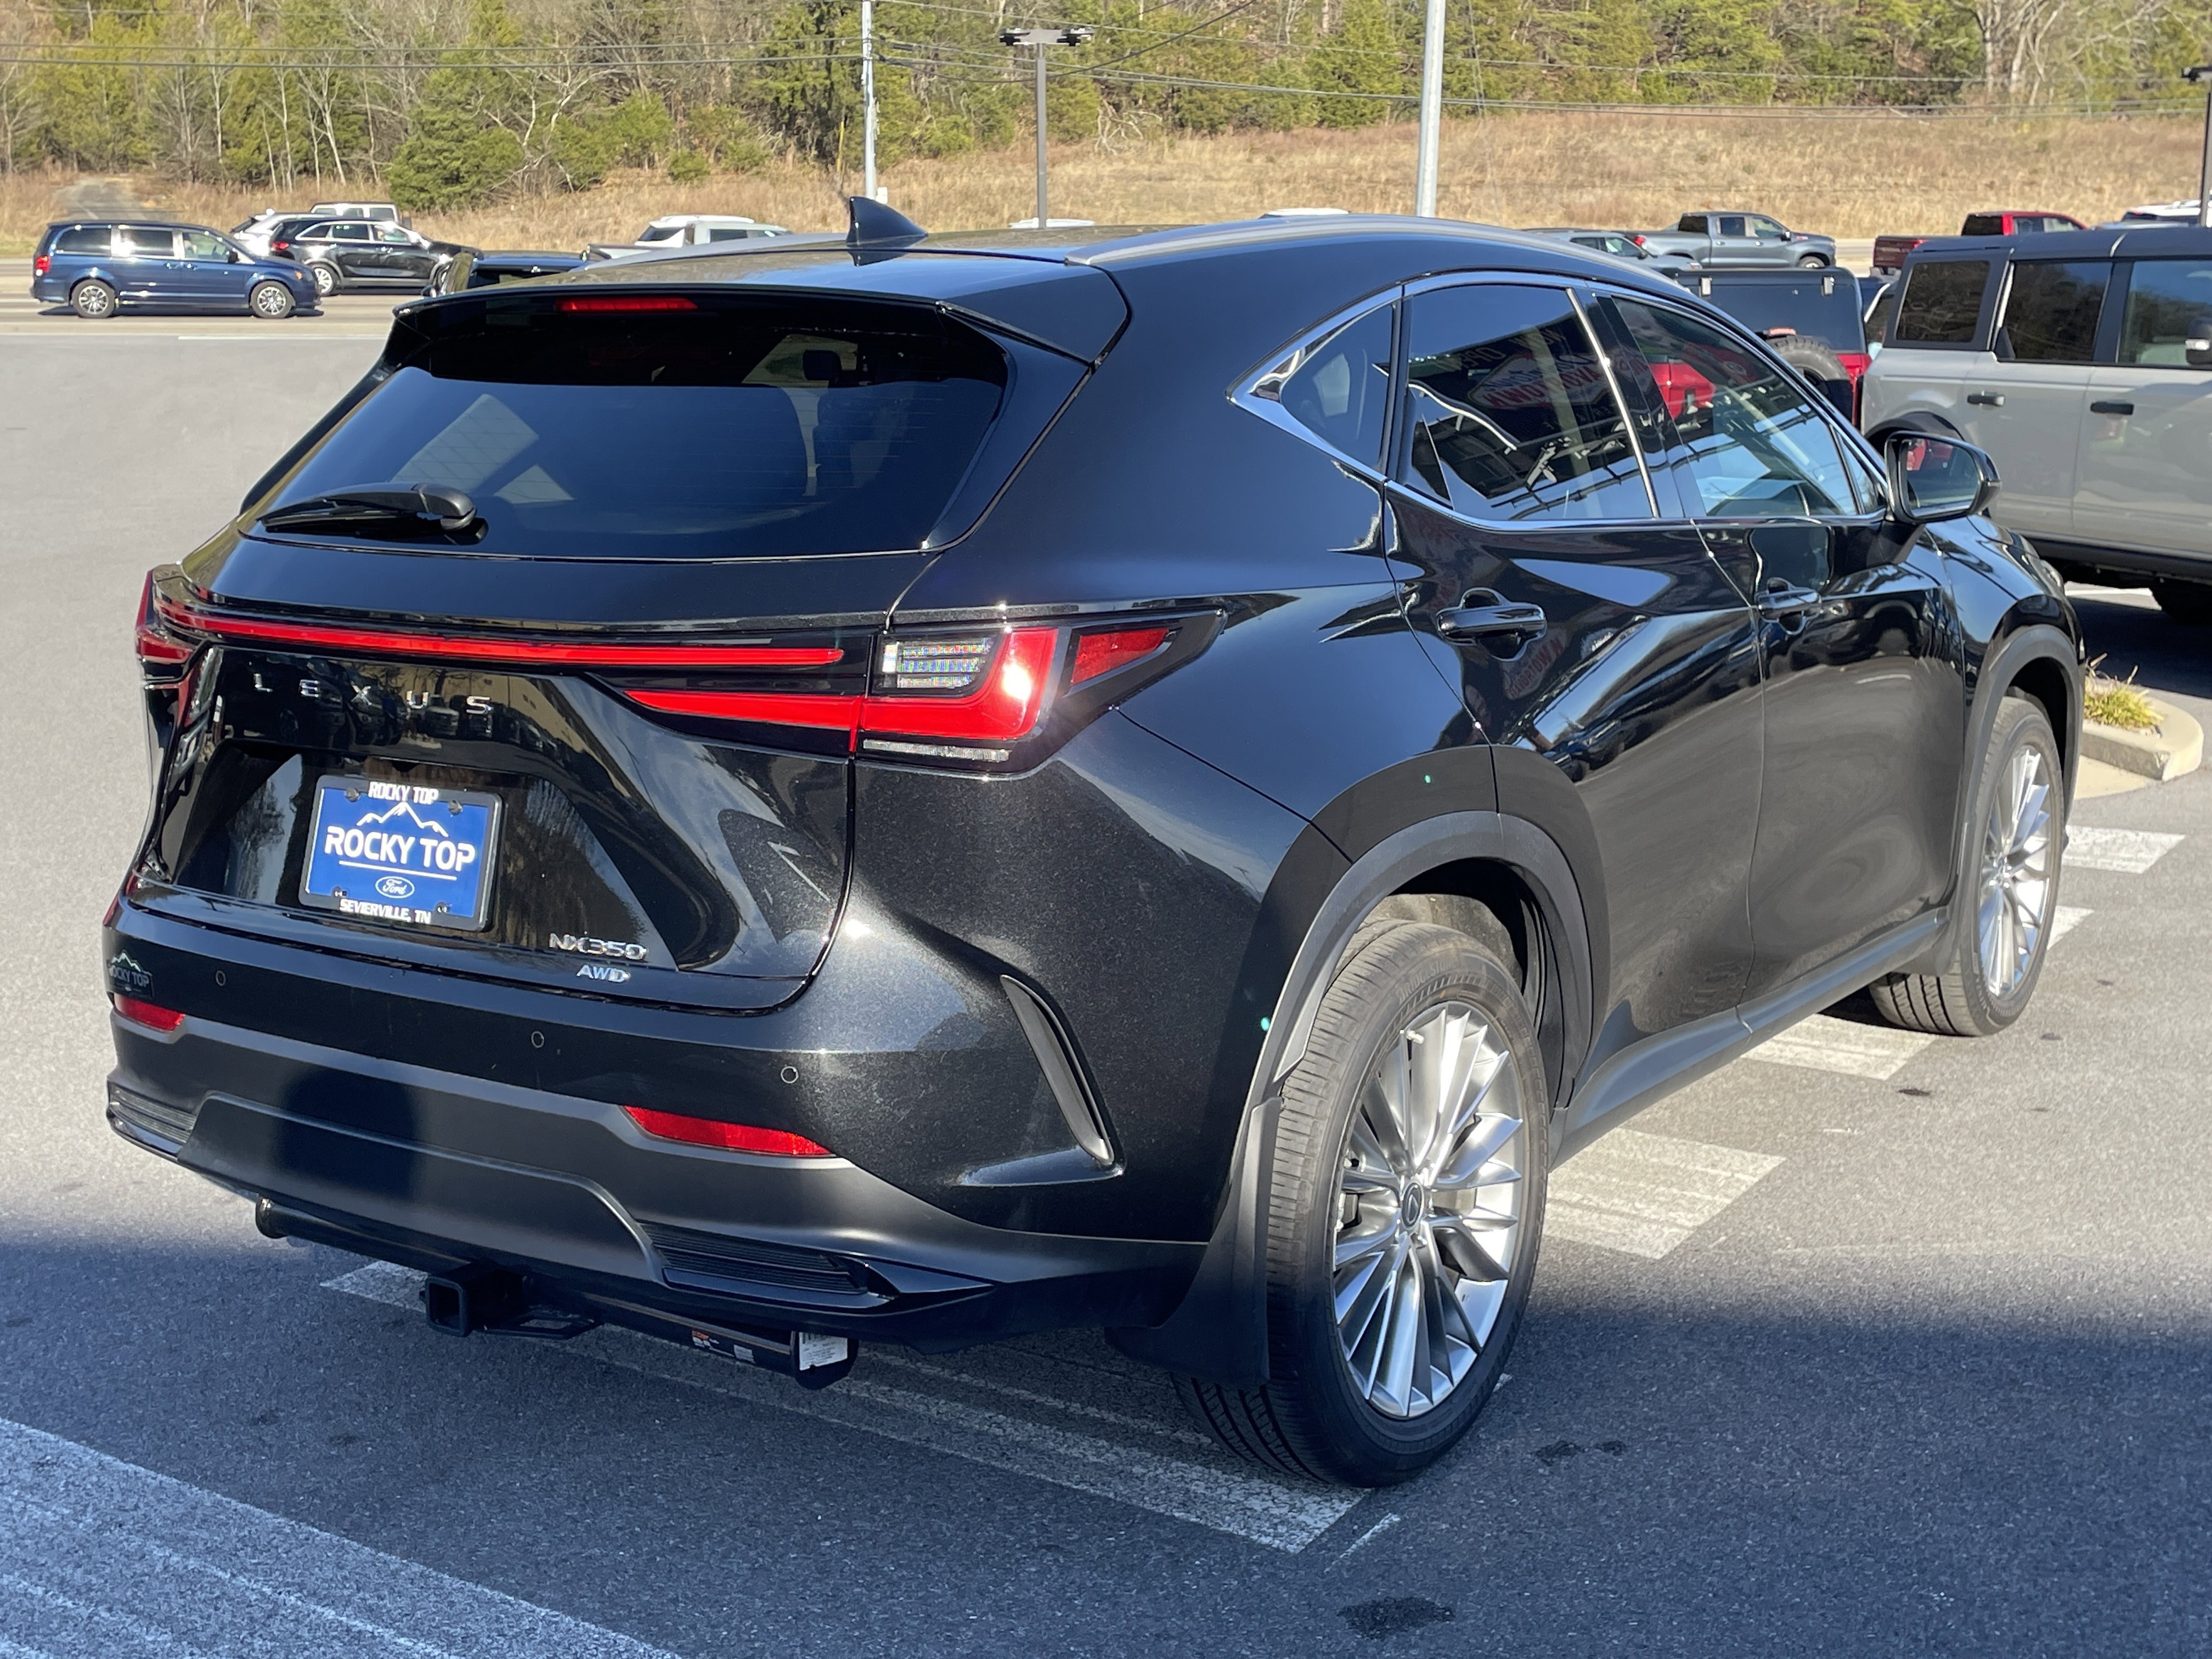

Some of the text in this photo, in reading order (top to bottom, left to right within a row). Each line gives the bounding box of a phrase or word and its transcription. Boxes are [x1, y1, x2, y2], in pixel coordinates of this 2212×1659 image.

[253, 673, 493, 714] LEXUS
[368, 781, 439, 804] ROCKY TOP
[324, 826, 475, 871] ROCKY TOP
[382, 878, 407, 894] Ford
[339, 898, 432, 924] SEVIERVILLE, TN
[549, 933, 648, 960] NX350
[132, 972, 149, 987] TOP
[577, 964, 630, 983] AWD
